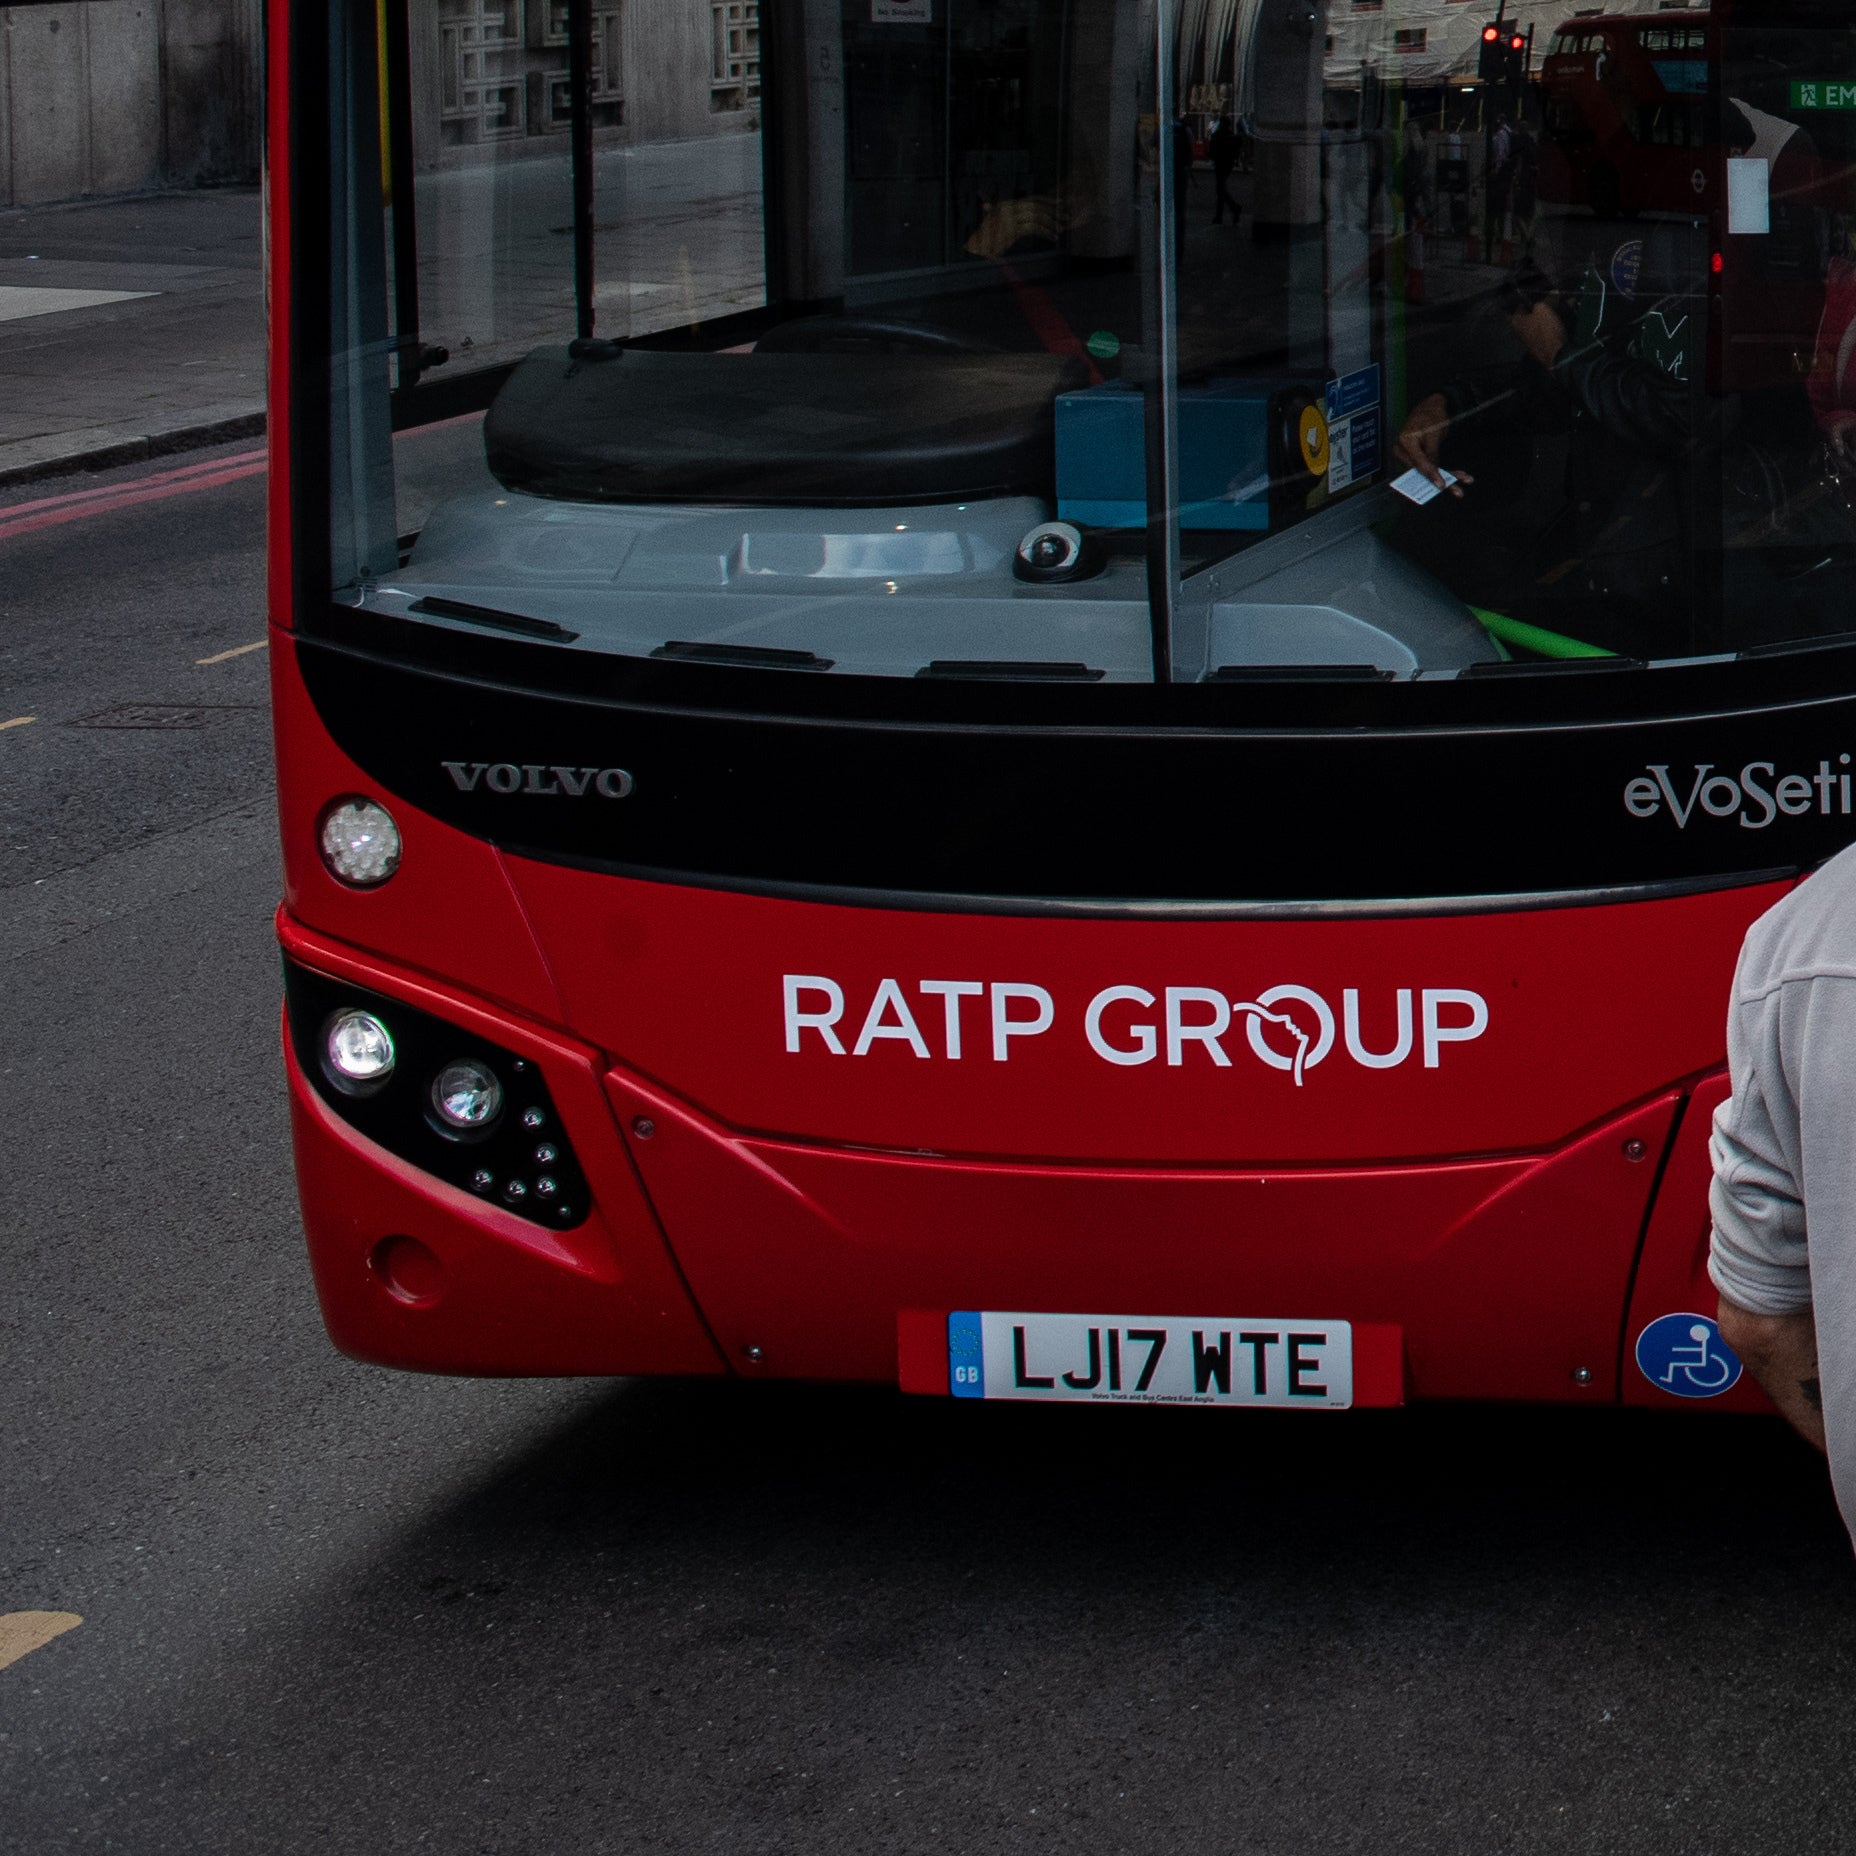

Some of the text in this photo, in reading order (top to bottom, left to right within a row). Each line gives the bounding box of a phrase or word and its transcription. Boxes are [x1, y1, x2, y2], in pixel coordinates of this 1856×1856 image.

[441, 761, 633, 799] VOLVO
[782, 974, 1489, 1085] RATP GROUP
[954, 1366, 979, 1383] GB
[1013, 1325, 1327, 1397] LJ17 WTE
